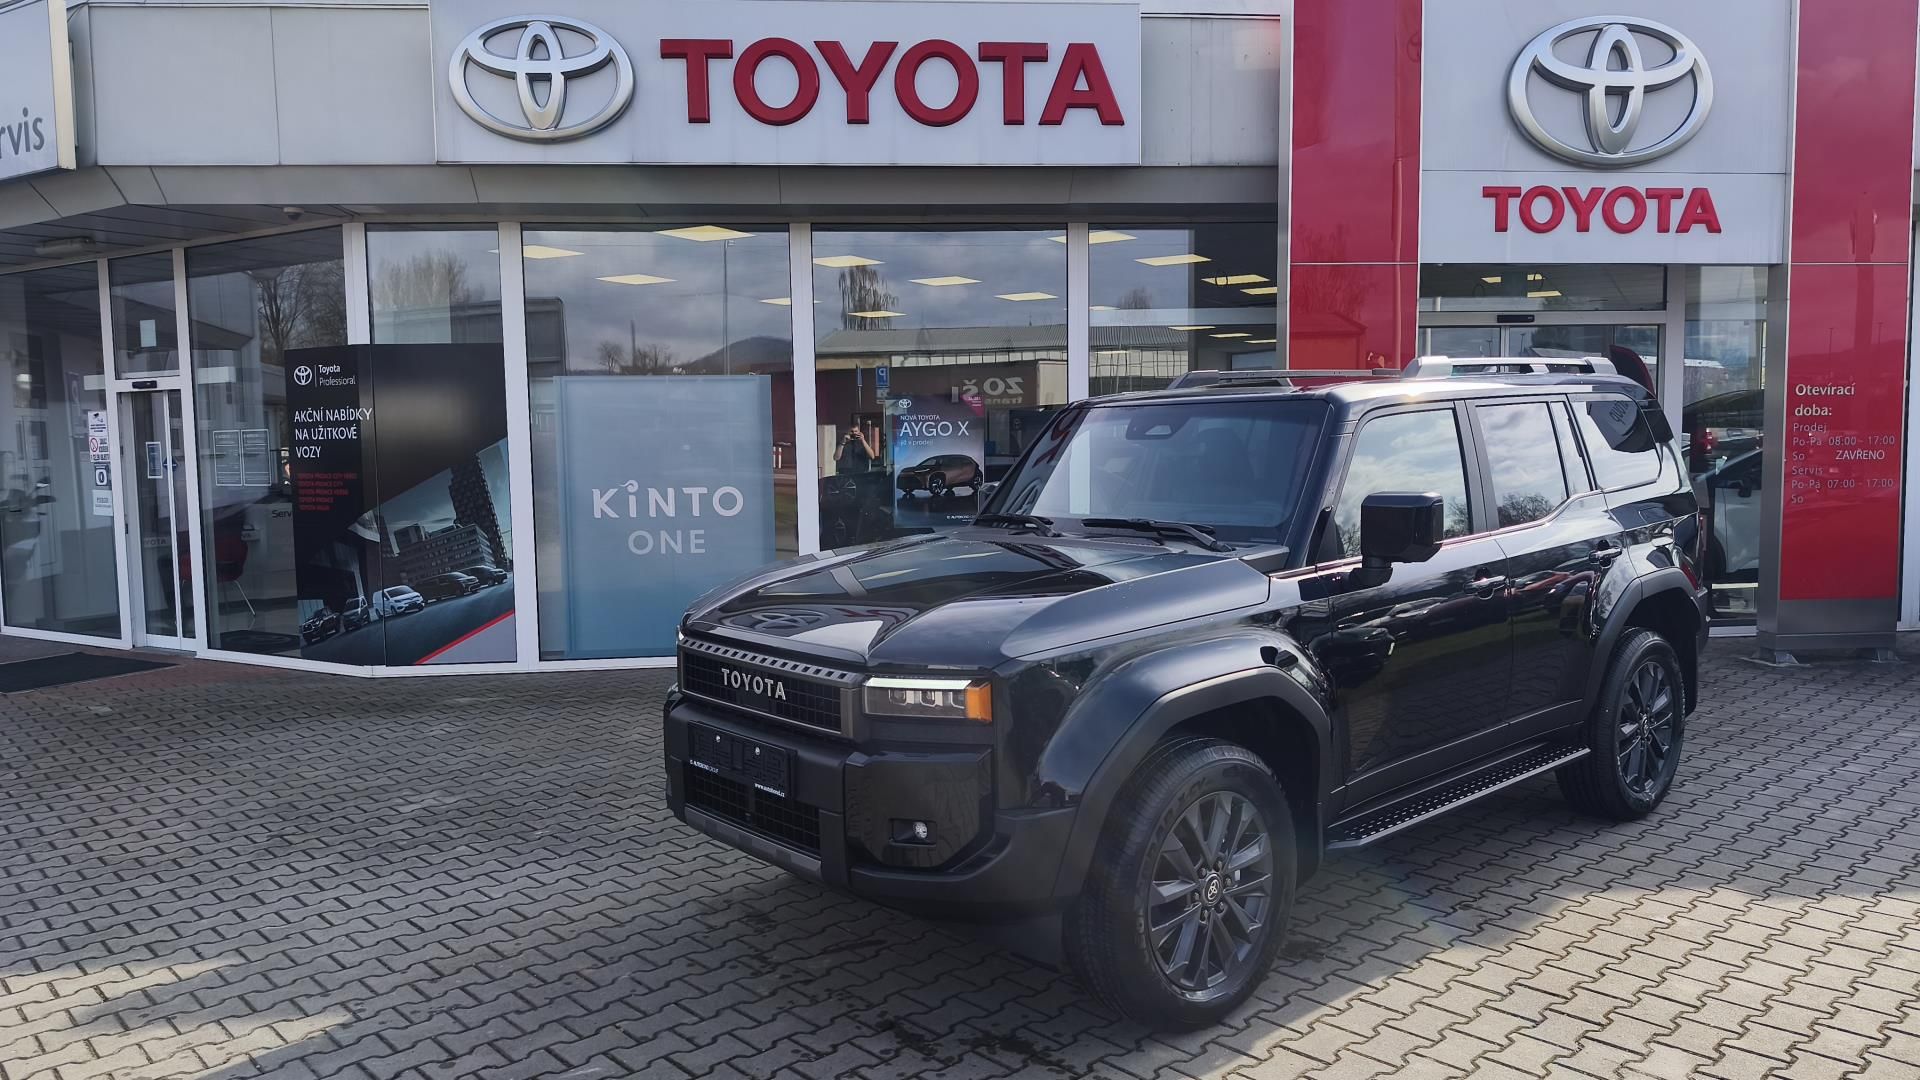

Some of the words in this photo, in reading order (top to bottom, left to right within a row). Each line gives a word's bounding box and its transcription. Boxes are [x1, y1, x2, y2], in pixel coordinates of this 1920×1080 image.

[660, 37, 1126, 127] TOYOTA
[1482, 185, 1722, 234] TOYOTA
[318, 364, 341, 375] Toyota
[1795, 382, 1857, 396] Otevírací
[294, 406, 324, 423] AKČNÍ
[325, 405, 373, 422] NABÍDKY
[1794, 403, 1833, 416] doba:
[295, 428, 310, 441] NA
[311, 423, 358, 440] UŽITKOVÉ
[899, 421, 953, 437] AYGO
[957, 421, 970, 437] X
[1793, 422, 1827, 434] Prodej
[1792, 436, 1822, 446] Po-Pá
[1828, 436, 1857, 446] 08:00
[1867, 435, 1895, 446] 17:00
[295, 446, 321, 459] VOZY
[1792, 451, 1805, 461] So
[1835, 449, 1885, 461] ZAVŘENO
[1791, 465, 1824, 475] Servis
[1791, 480, 1821, 489] Po-Pá
[1827, 479, 1855, 489] 07:00
[1866, 478, 1894, 488] 17:00
[1791, 493, 1804, 504] So
[627, 529, 706, 555] ONE
[721, 668, 787, 701] TOYOTA
